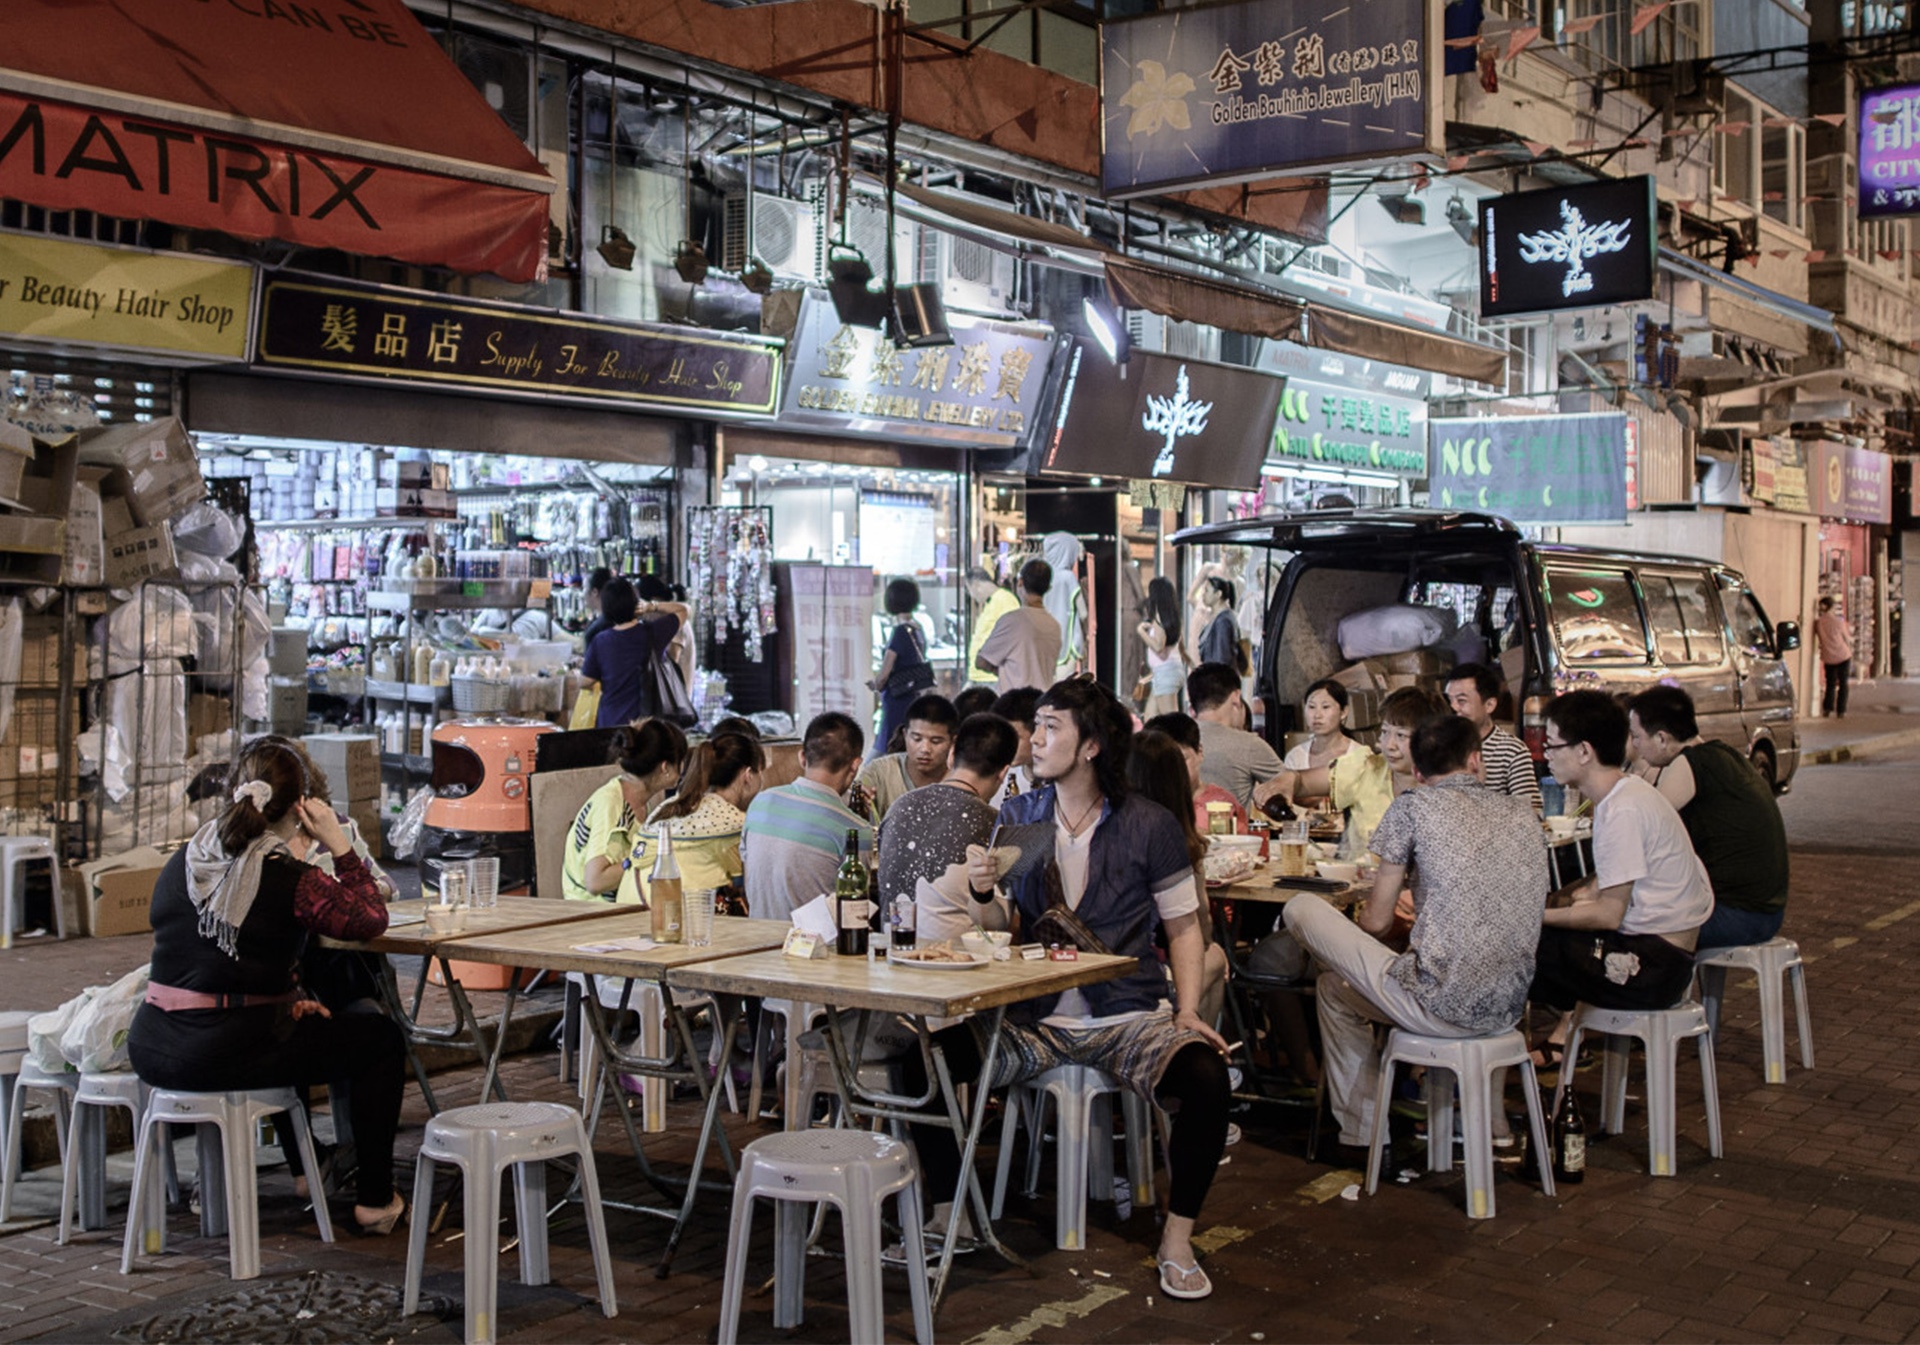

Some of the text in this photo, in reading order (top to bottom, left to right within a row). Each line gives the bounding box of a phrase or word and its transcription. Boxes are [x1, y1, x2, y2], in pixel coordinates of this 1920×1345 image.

[338, 13, 408, 49] BE
[1211, 95, 1260, 125] Golden
[1258, 86, 1317, 117] Bauhinia
[1317, 77, 1384, 109] Jewellery
[21, 276, 107, 320] Beauty
[114, 288, 170, 319] Hair
[177, 294, 234, 334] Shop
[321, 303, 464, 363] 髮品店
[480, 330, 743, 399] Supply For Beauty Hair Shop
[798, 384, 857, 411] GOLDEN
[923, 400, 998, 429] JEWELLERY
[1442, 437, 1493, 477] NCC
